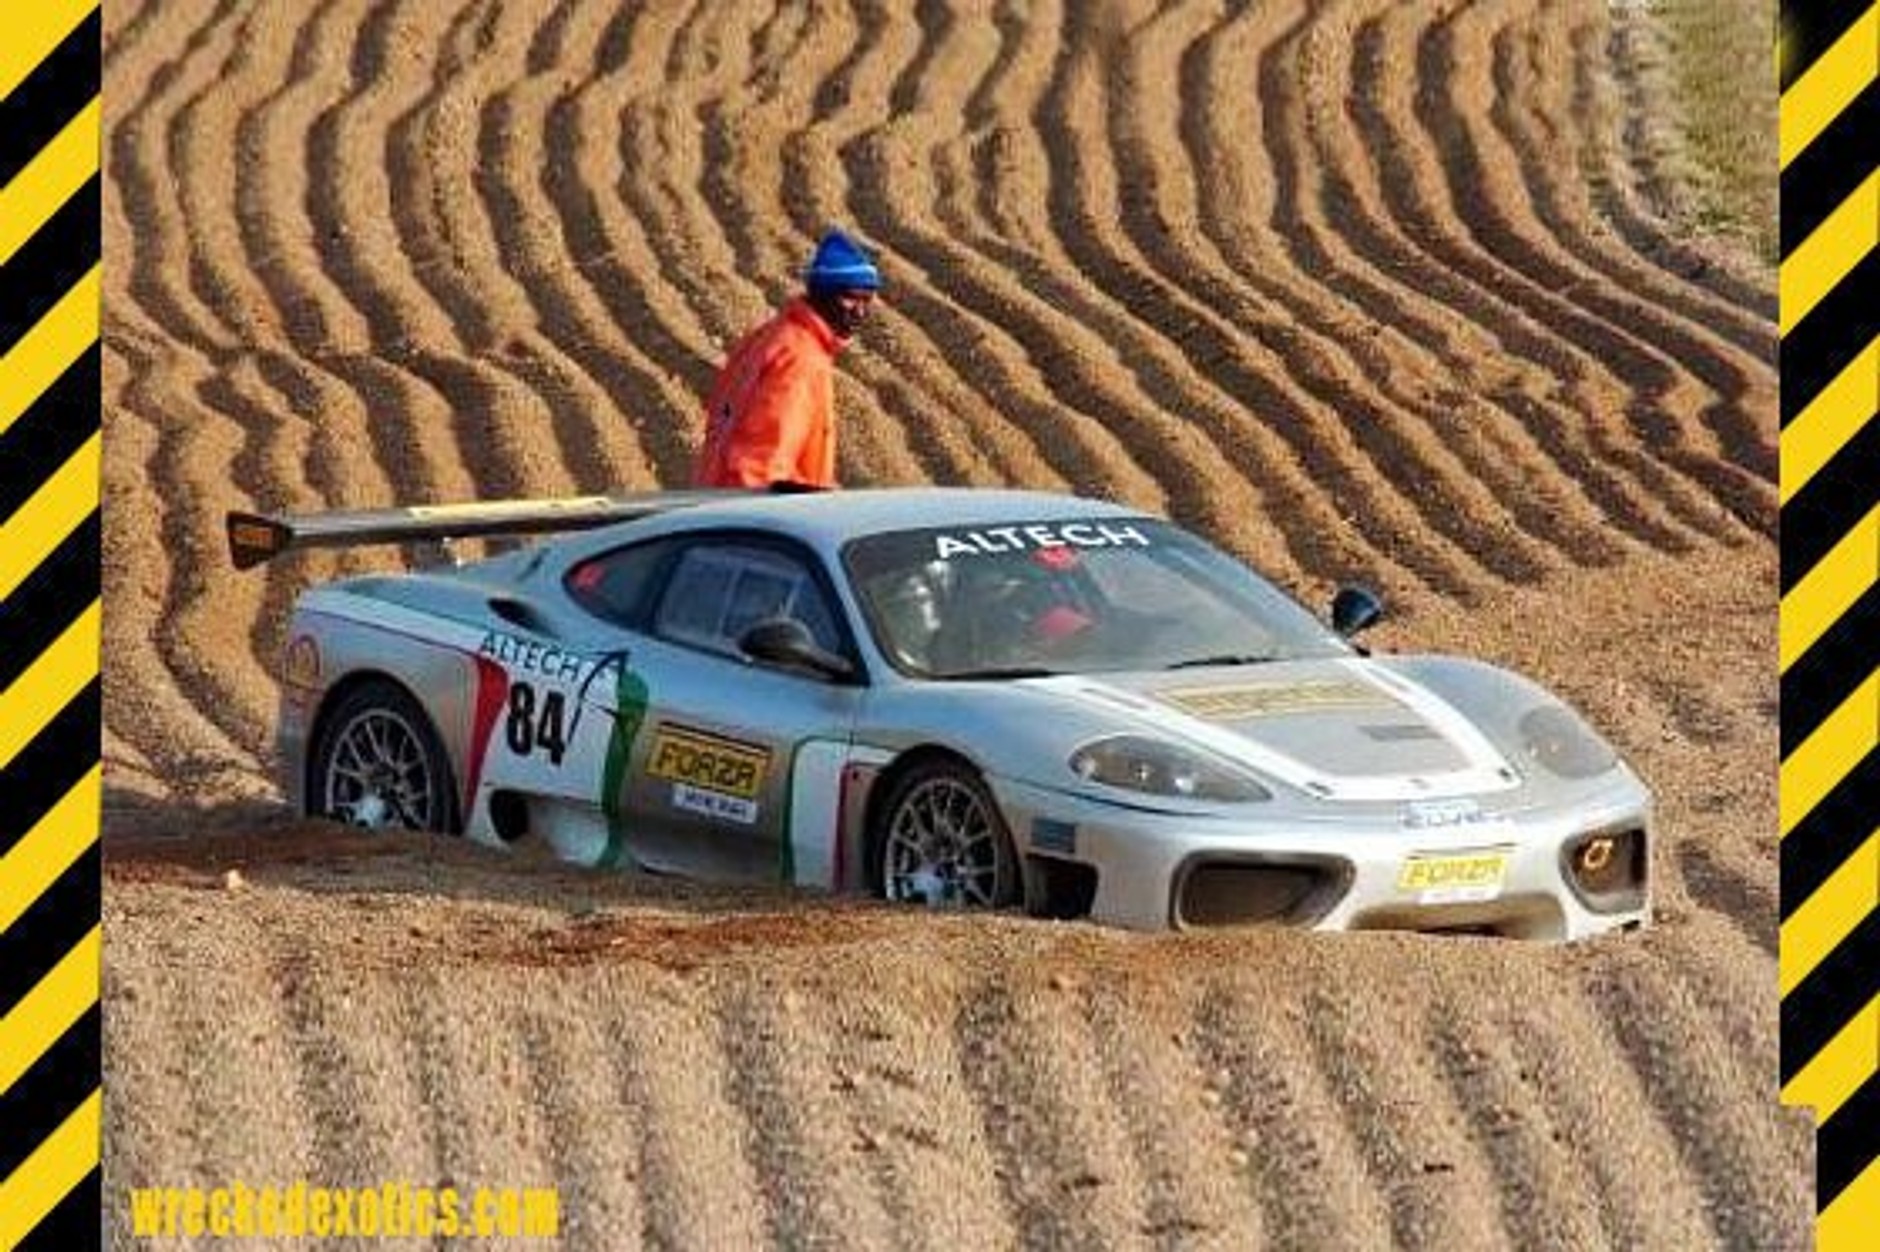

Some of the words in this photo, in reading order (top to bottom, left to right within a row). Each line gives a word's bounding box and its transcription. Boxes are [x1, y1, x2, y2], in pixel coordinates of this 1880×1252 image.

[936, 524, 1150, 559] ALTECH
[479, 629, 580, 684] ALTECH
[507, 681, 566, 767] 84
[657, 741, 757, 791] FORZA
